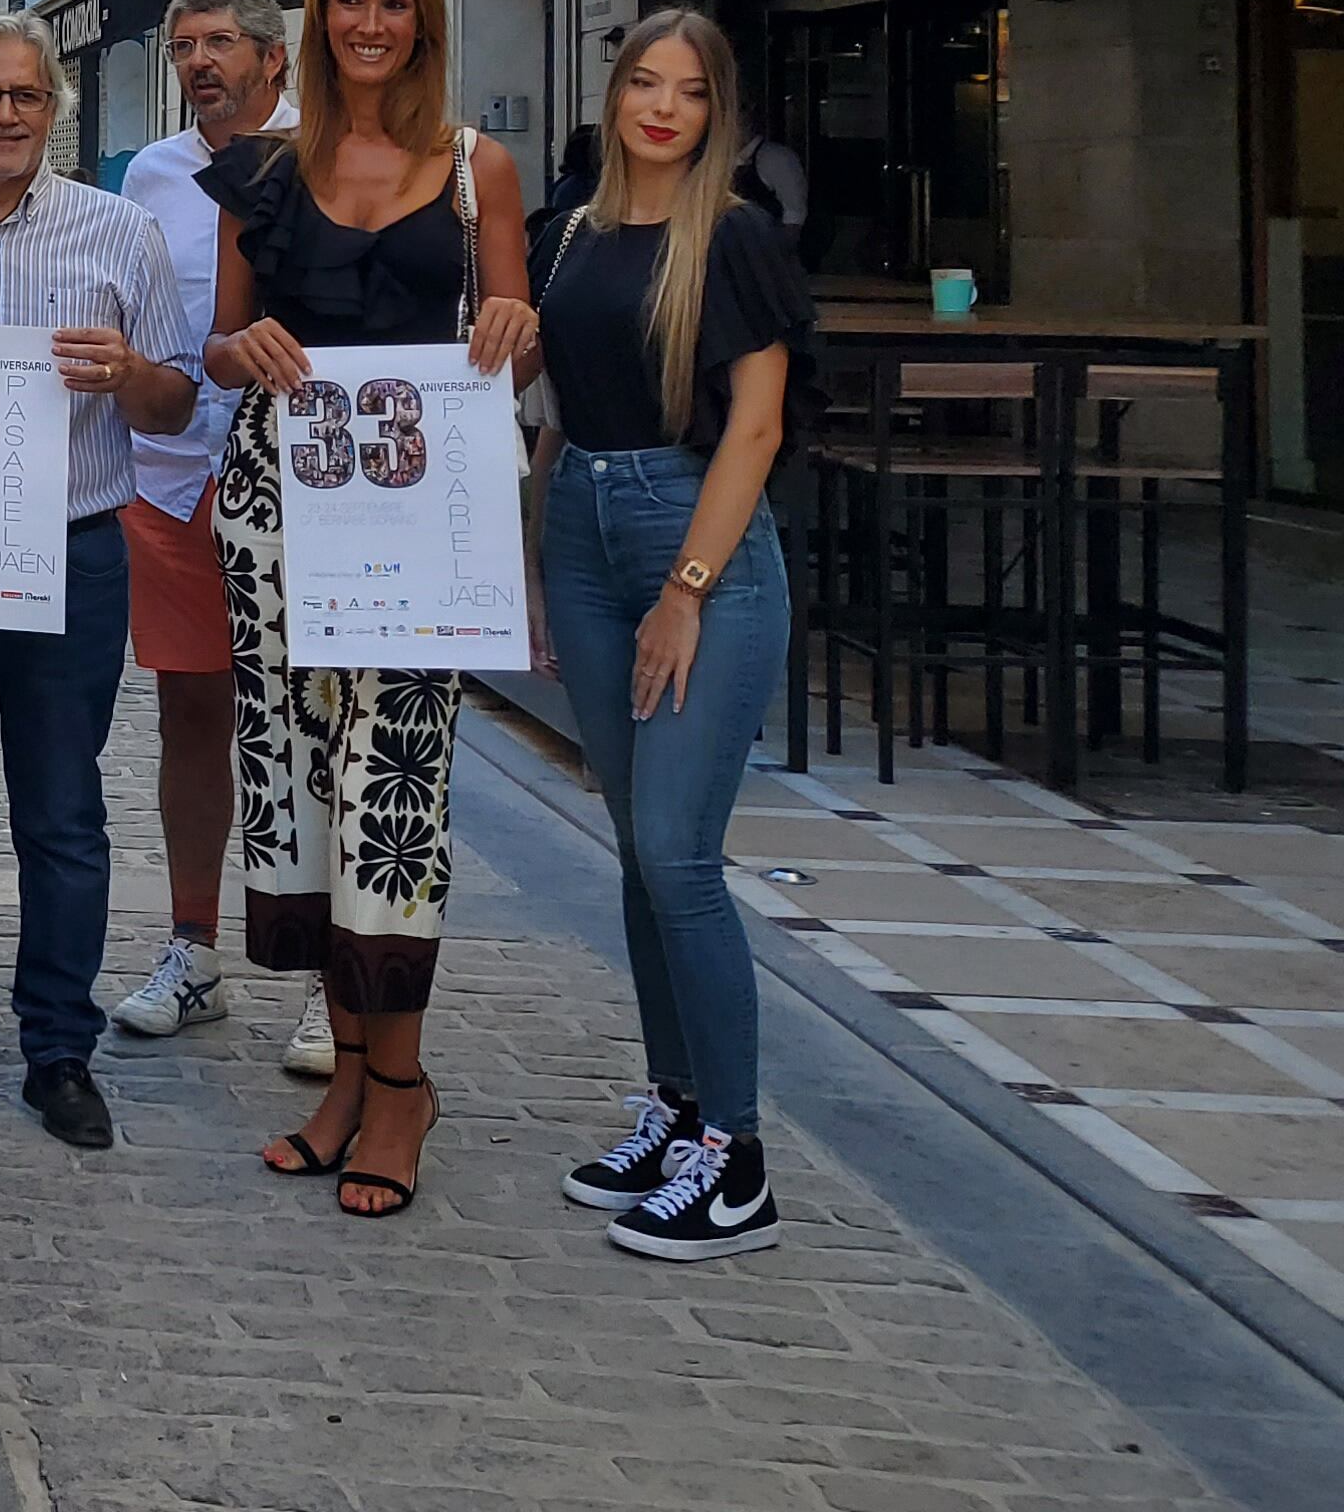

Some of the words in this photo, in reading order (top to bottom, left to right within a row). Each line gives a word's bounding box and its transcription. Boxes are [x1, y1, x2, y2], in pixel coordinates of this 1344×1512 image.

[419, 381, 492, 393] ANIVERSARIO
[288, 378, 427, 489] 33
[439, 582, 514, 607] JAÉN
